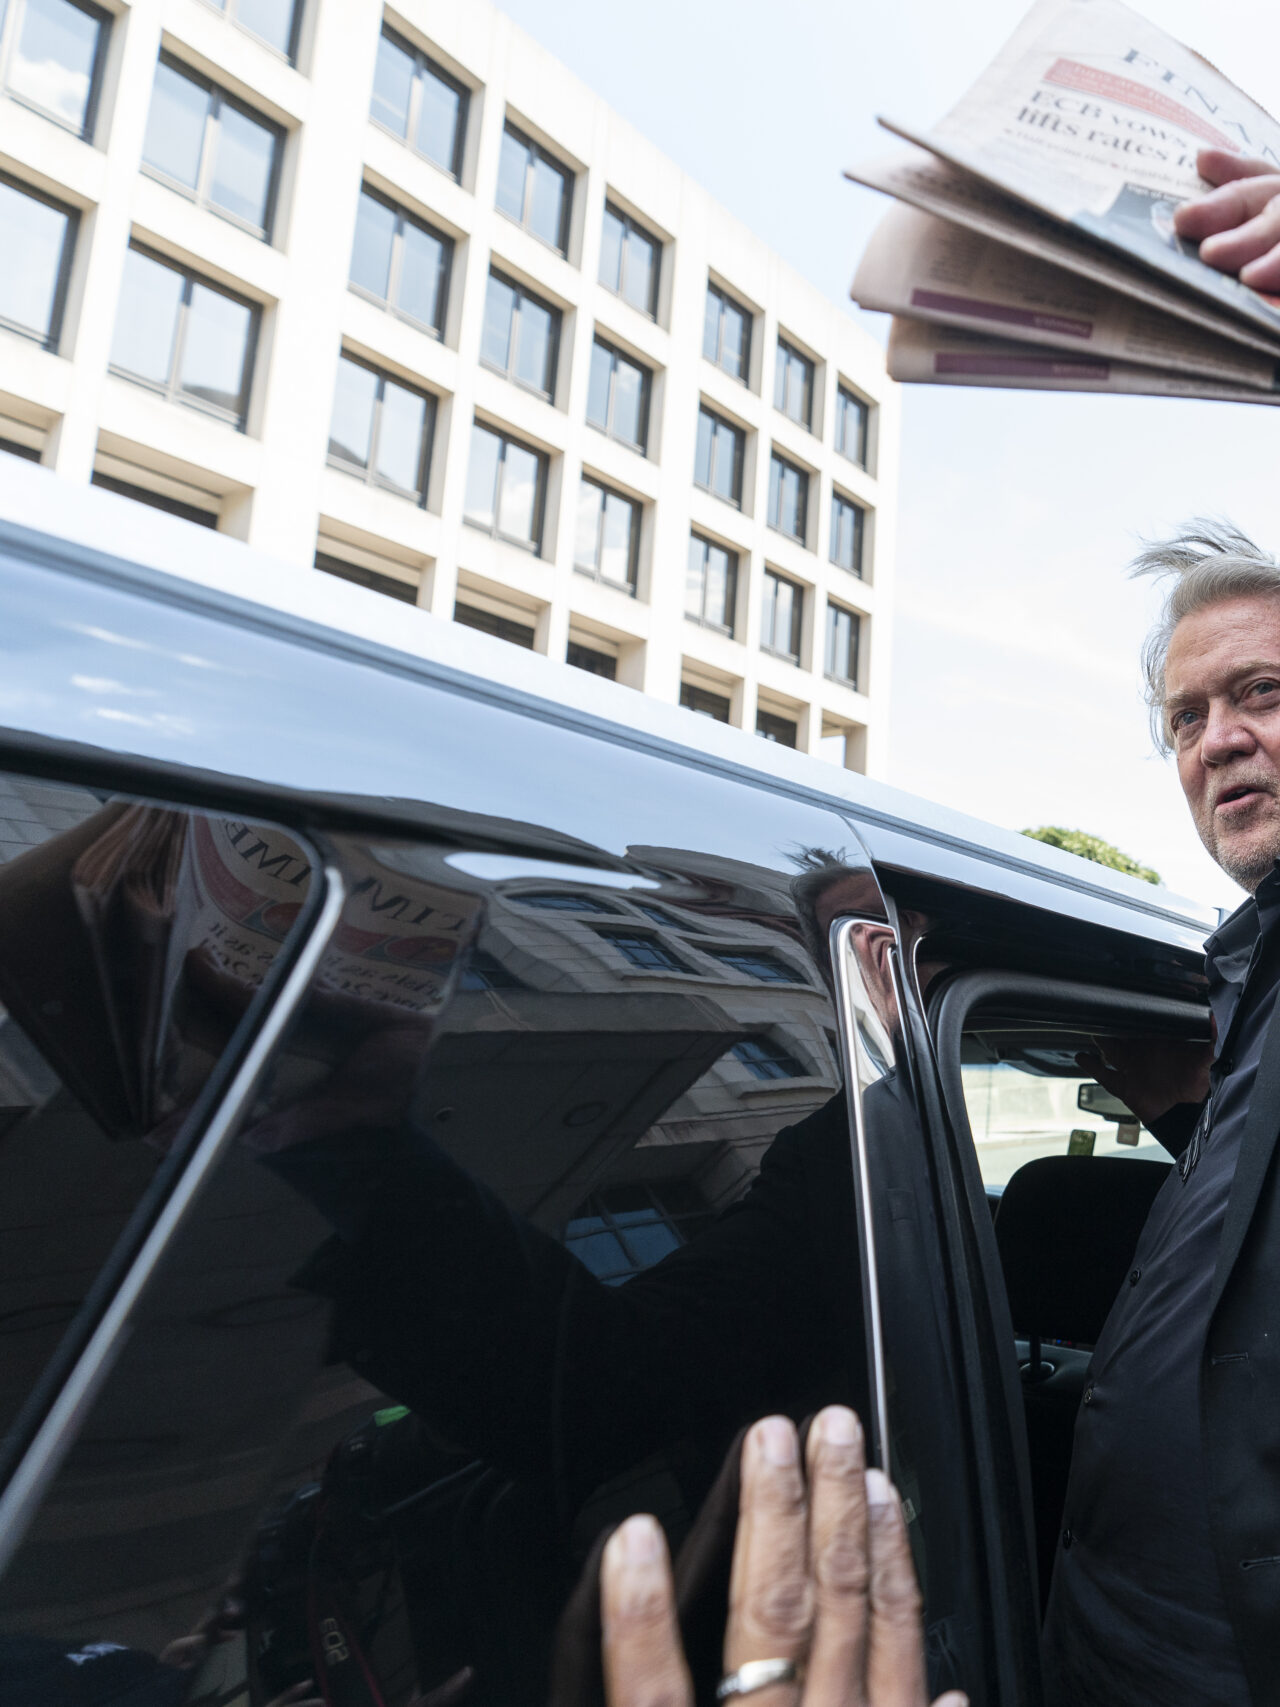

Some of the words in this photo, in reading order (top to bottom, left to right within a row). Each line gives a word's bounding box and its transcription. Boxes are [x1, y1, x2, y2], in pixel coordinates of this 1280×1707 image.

[1015, 106, 1079, 136] lifts
[1087, 131, 1169, 162] rates
[1030, 89, 1101, 119] ECB
[1111, 110, 1189, 149] vows
